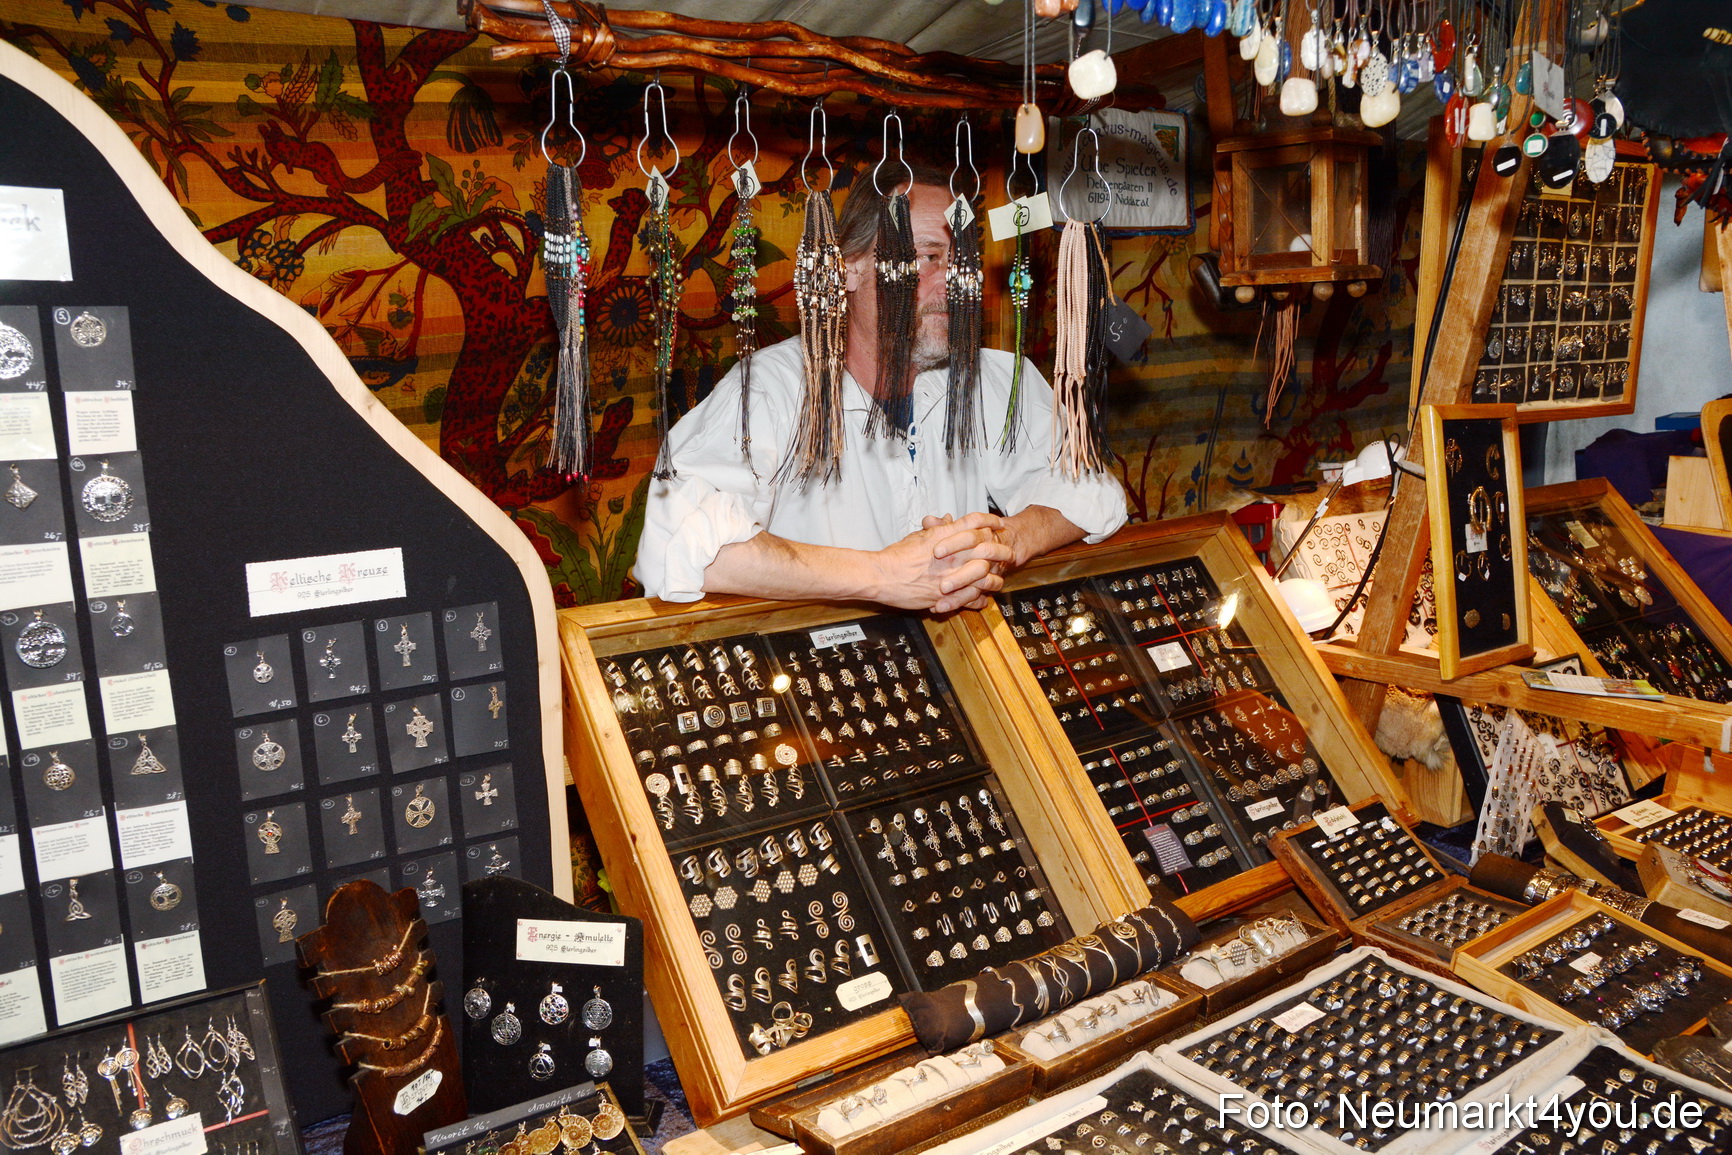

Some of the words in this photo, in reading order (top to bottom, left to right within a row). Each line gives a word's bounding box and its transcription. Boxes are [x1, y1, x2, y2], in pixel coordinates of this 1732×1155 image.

[270, 570, 332, 593] Keltische
[339, 563, 389, 585] Kreuze
[528, 926, 562, 942] Energie
[130, 1126, 198, 1149] Ohrschmuck
